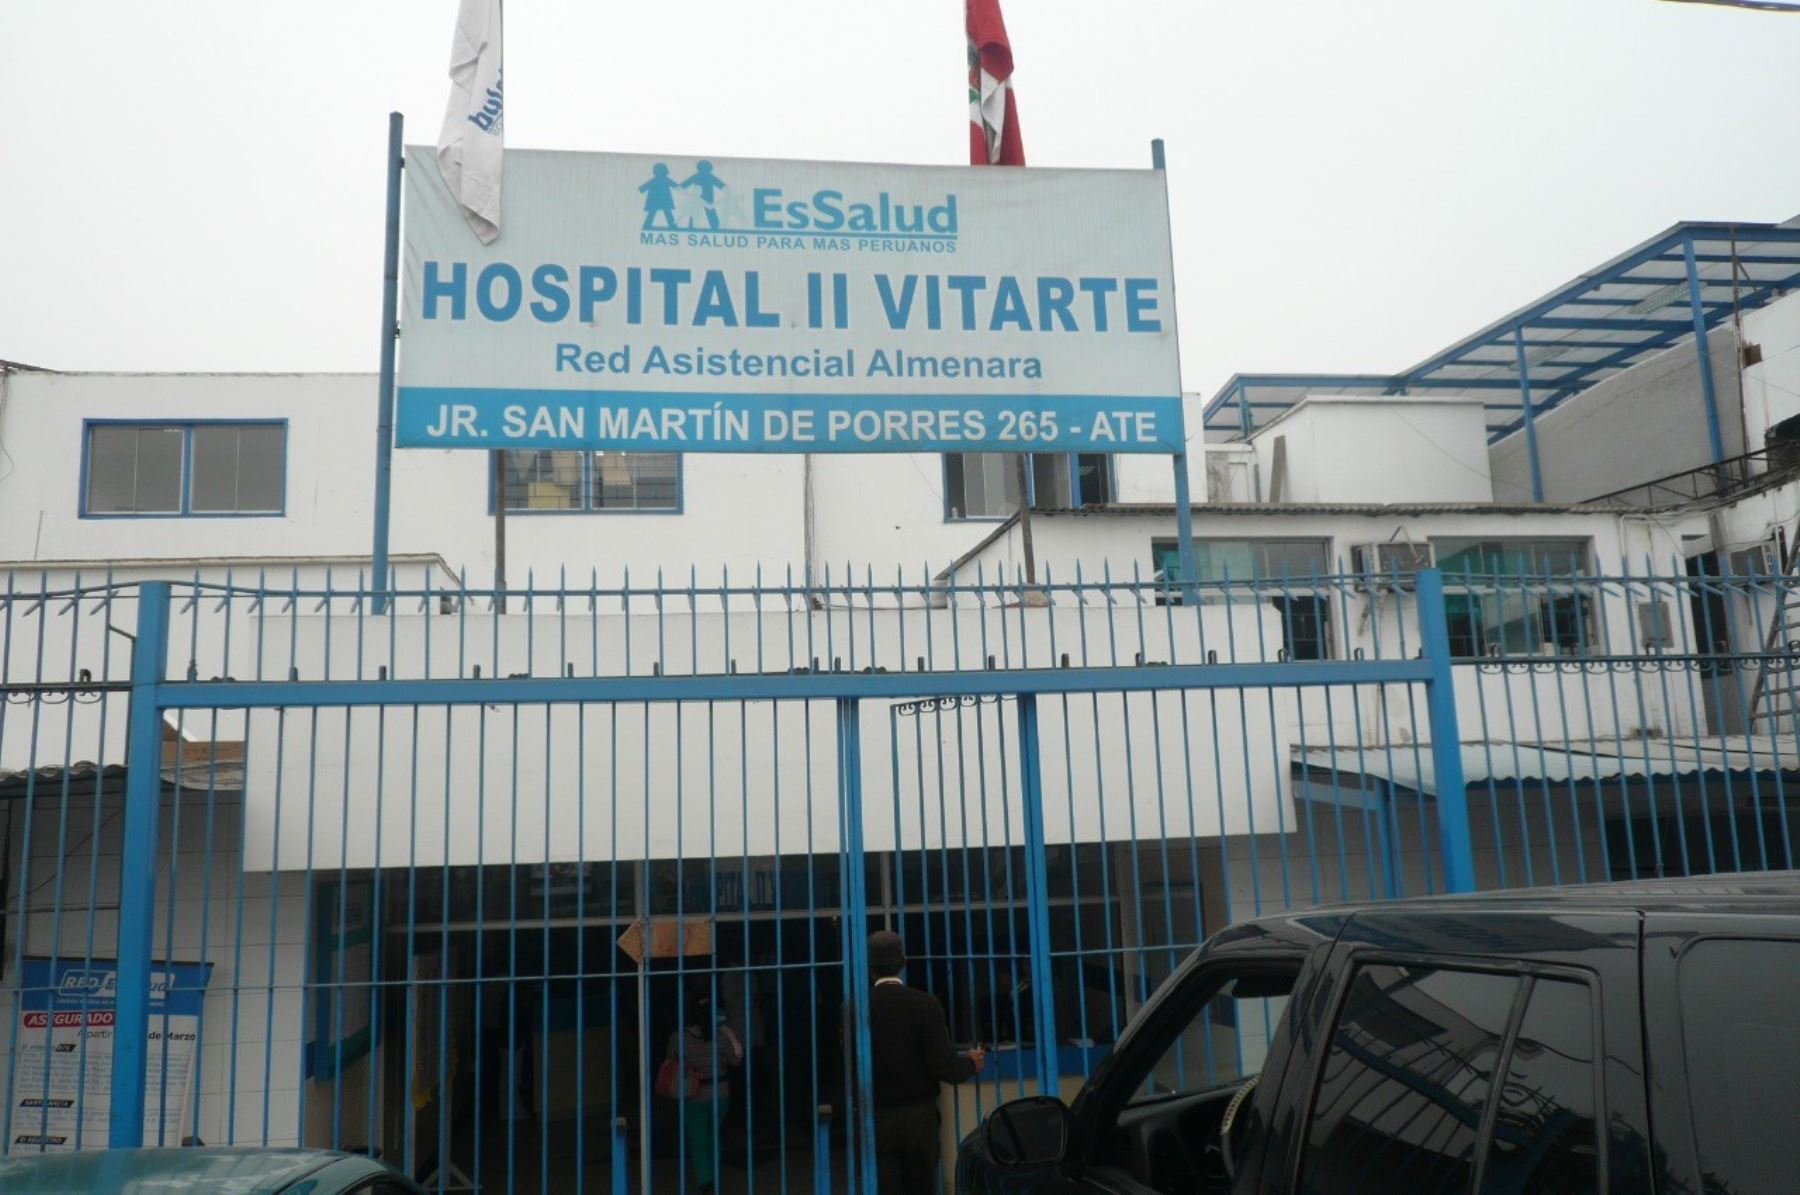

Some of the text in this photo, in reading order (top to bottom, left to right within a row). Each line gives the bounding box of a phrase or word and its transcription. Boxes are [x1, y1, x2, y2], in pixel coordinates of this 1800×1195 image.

[753, 188, 958, 233] EsSalud
[640, 232, 956, 253] MAS SALUD PARA MAS PERUANOS
[422, 261, 1162, 333] HOSPITAL II VITARTE
[555, 343, 1042, 378] Red Asistencial Almenara
[426, 404, 488, 438] JR.
[503, 405, 584, 438] SAN
[600, 401, 749, 441] MARTÍN
[764, 409, 814, 441] DE
[829, 410, 986, 442] PORRES
[998, 410, 1058, 442] 265
[1089, 411, 1158, 442] ATE
[64, 976, 98, 990] RED
